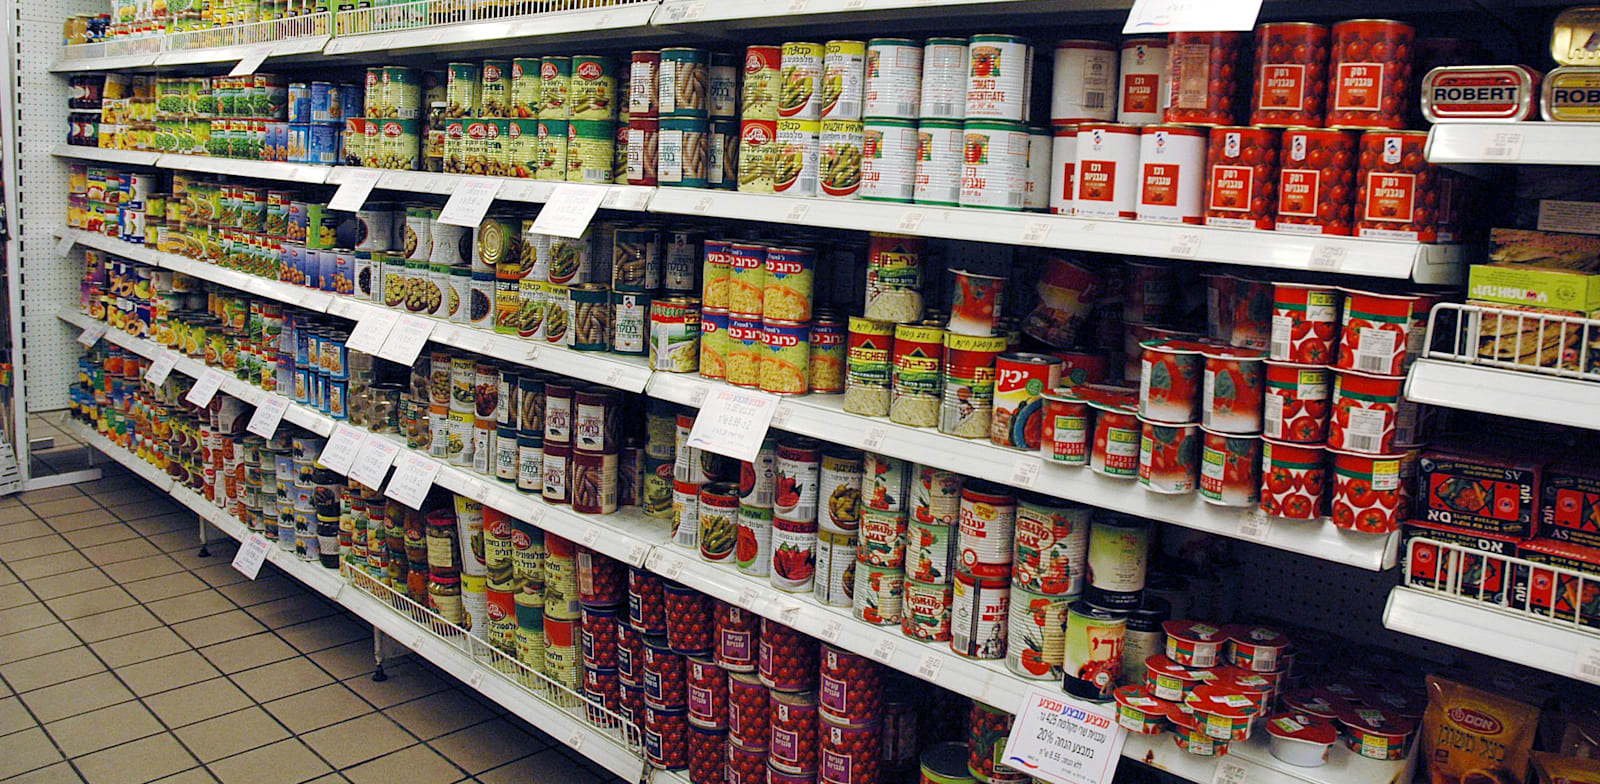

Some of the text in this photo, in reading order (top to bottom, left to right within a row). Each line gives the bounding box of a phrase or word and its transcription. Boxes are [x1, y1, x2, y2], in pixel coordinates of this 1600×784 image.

[1274, 68, 1290, 79] רסק
[1351, 66, 1368, 78] רסק
[1267, 78, 1296, 89] עגבניות
[1343, 77, 1374, 88] עגבניות
[1434, 86, 1518, 102] ROBERT
[1223, 170, 1238, 180] רסק
[1289, 173, 1304, 184] רסק
[1217, 179, 1244, 190] עגבניות
[1285, 183, 1310, 194] עגבניות
[1381, 177, 1399, 188] רסק
[1374, 187, 1405, 199] עגבניות
[736, 257, 758, 268] כרוב
[776, 262, 801, 273] כרוב
[772, 335, 797, 345] כרוב
[1000, 368, 1029, 388] יכין
[866, 523, 894, 538] TOMATO
[1552, 528, 1569, 540] AS
[1478, 539, 1504, 553] אס
[911, 595, 941, 611] TOMATO
[1037, 698, 1063, 713] מבצע
[1061, 705, 1087, 721] מבצע
[1084, 713, 1111, 729] מבצע
[1036, 727, 1095, 759] במבצע הנחה 20%
